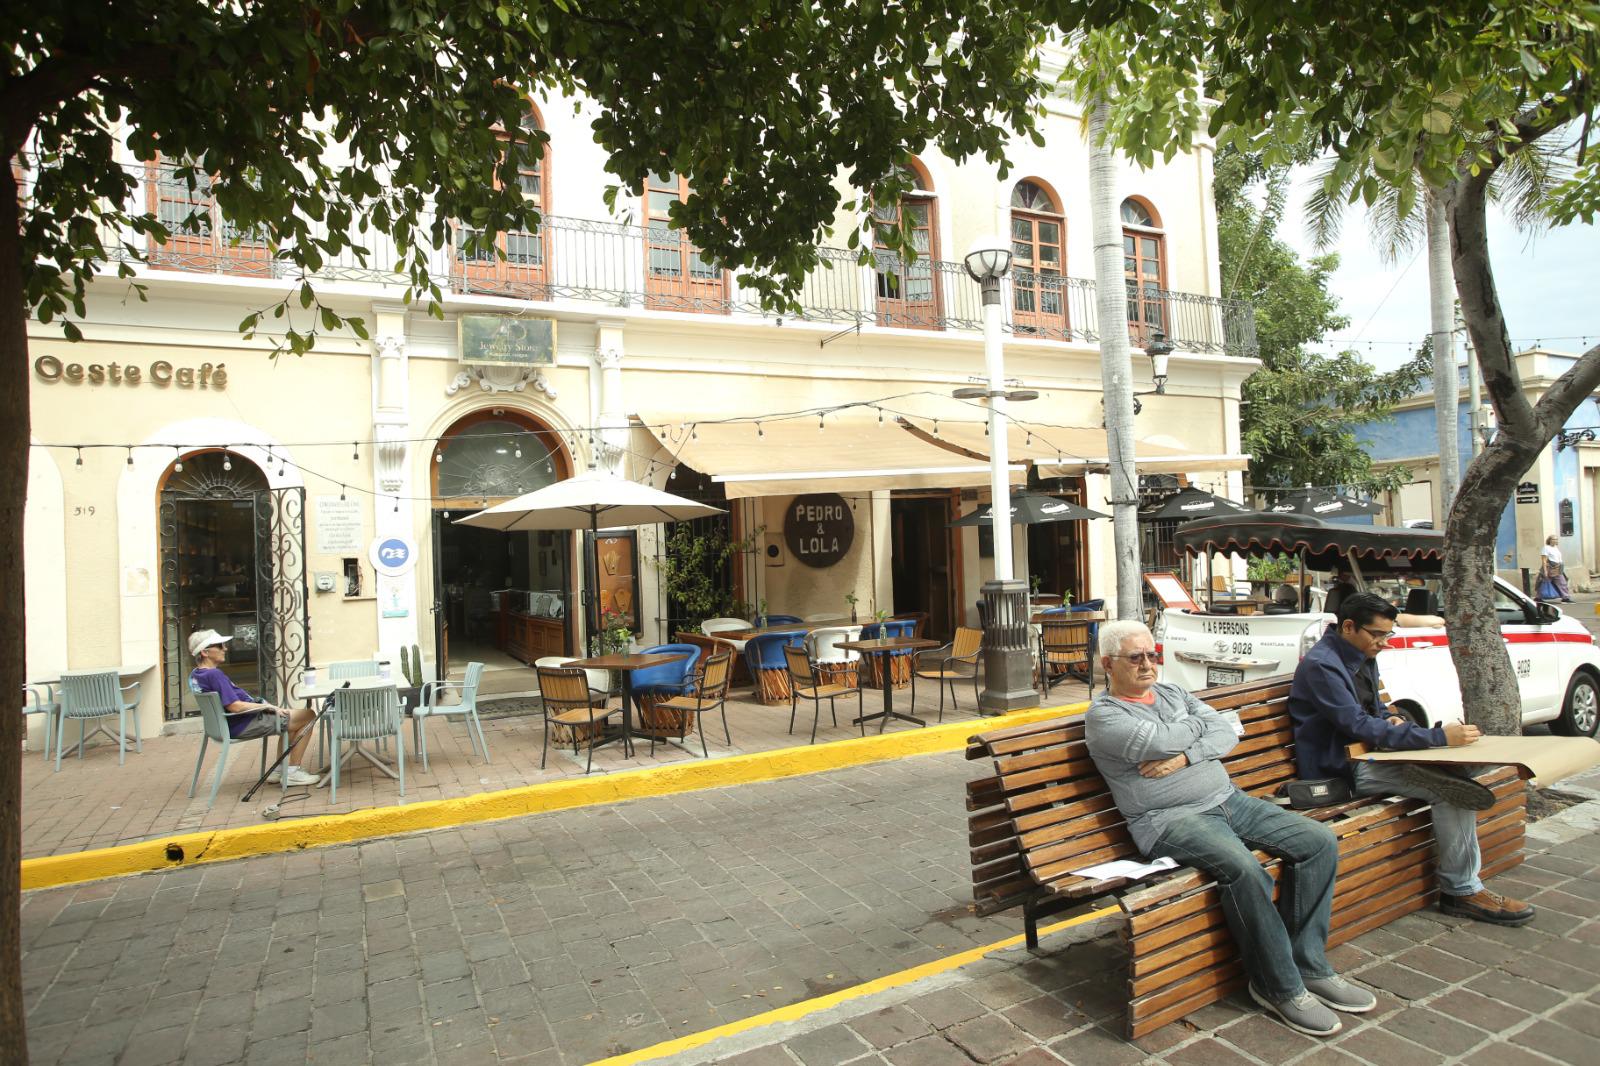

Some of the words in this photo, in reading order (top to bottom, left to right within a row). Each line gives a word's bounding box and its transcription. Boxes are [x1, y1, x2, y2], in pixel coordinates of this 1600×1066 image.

[34, 355, 142, 383] Oeste
[150, 360, 228, 388] Café
[796, 504, 843, 522] PEDRO
[816, 522, 825, 535] &
[800, 537, 839, 554] LOLA
[1207, 621, 1212, 633] A
[1213, 622, 1218, 634] 6
[1218, 622, 1250, 636] PERSONS
[1232, 641, 1253, 655] 9028
